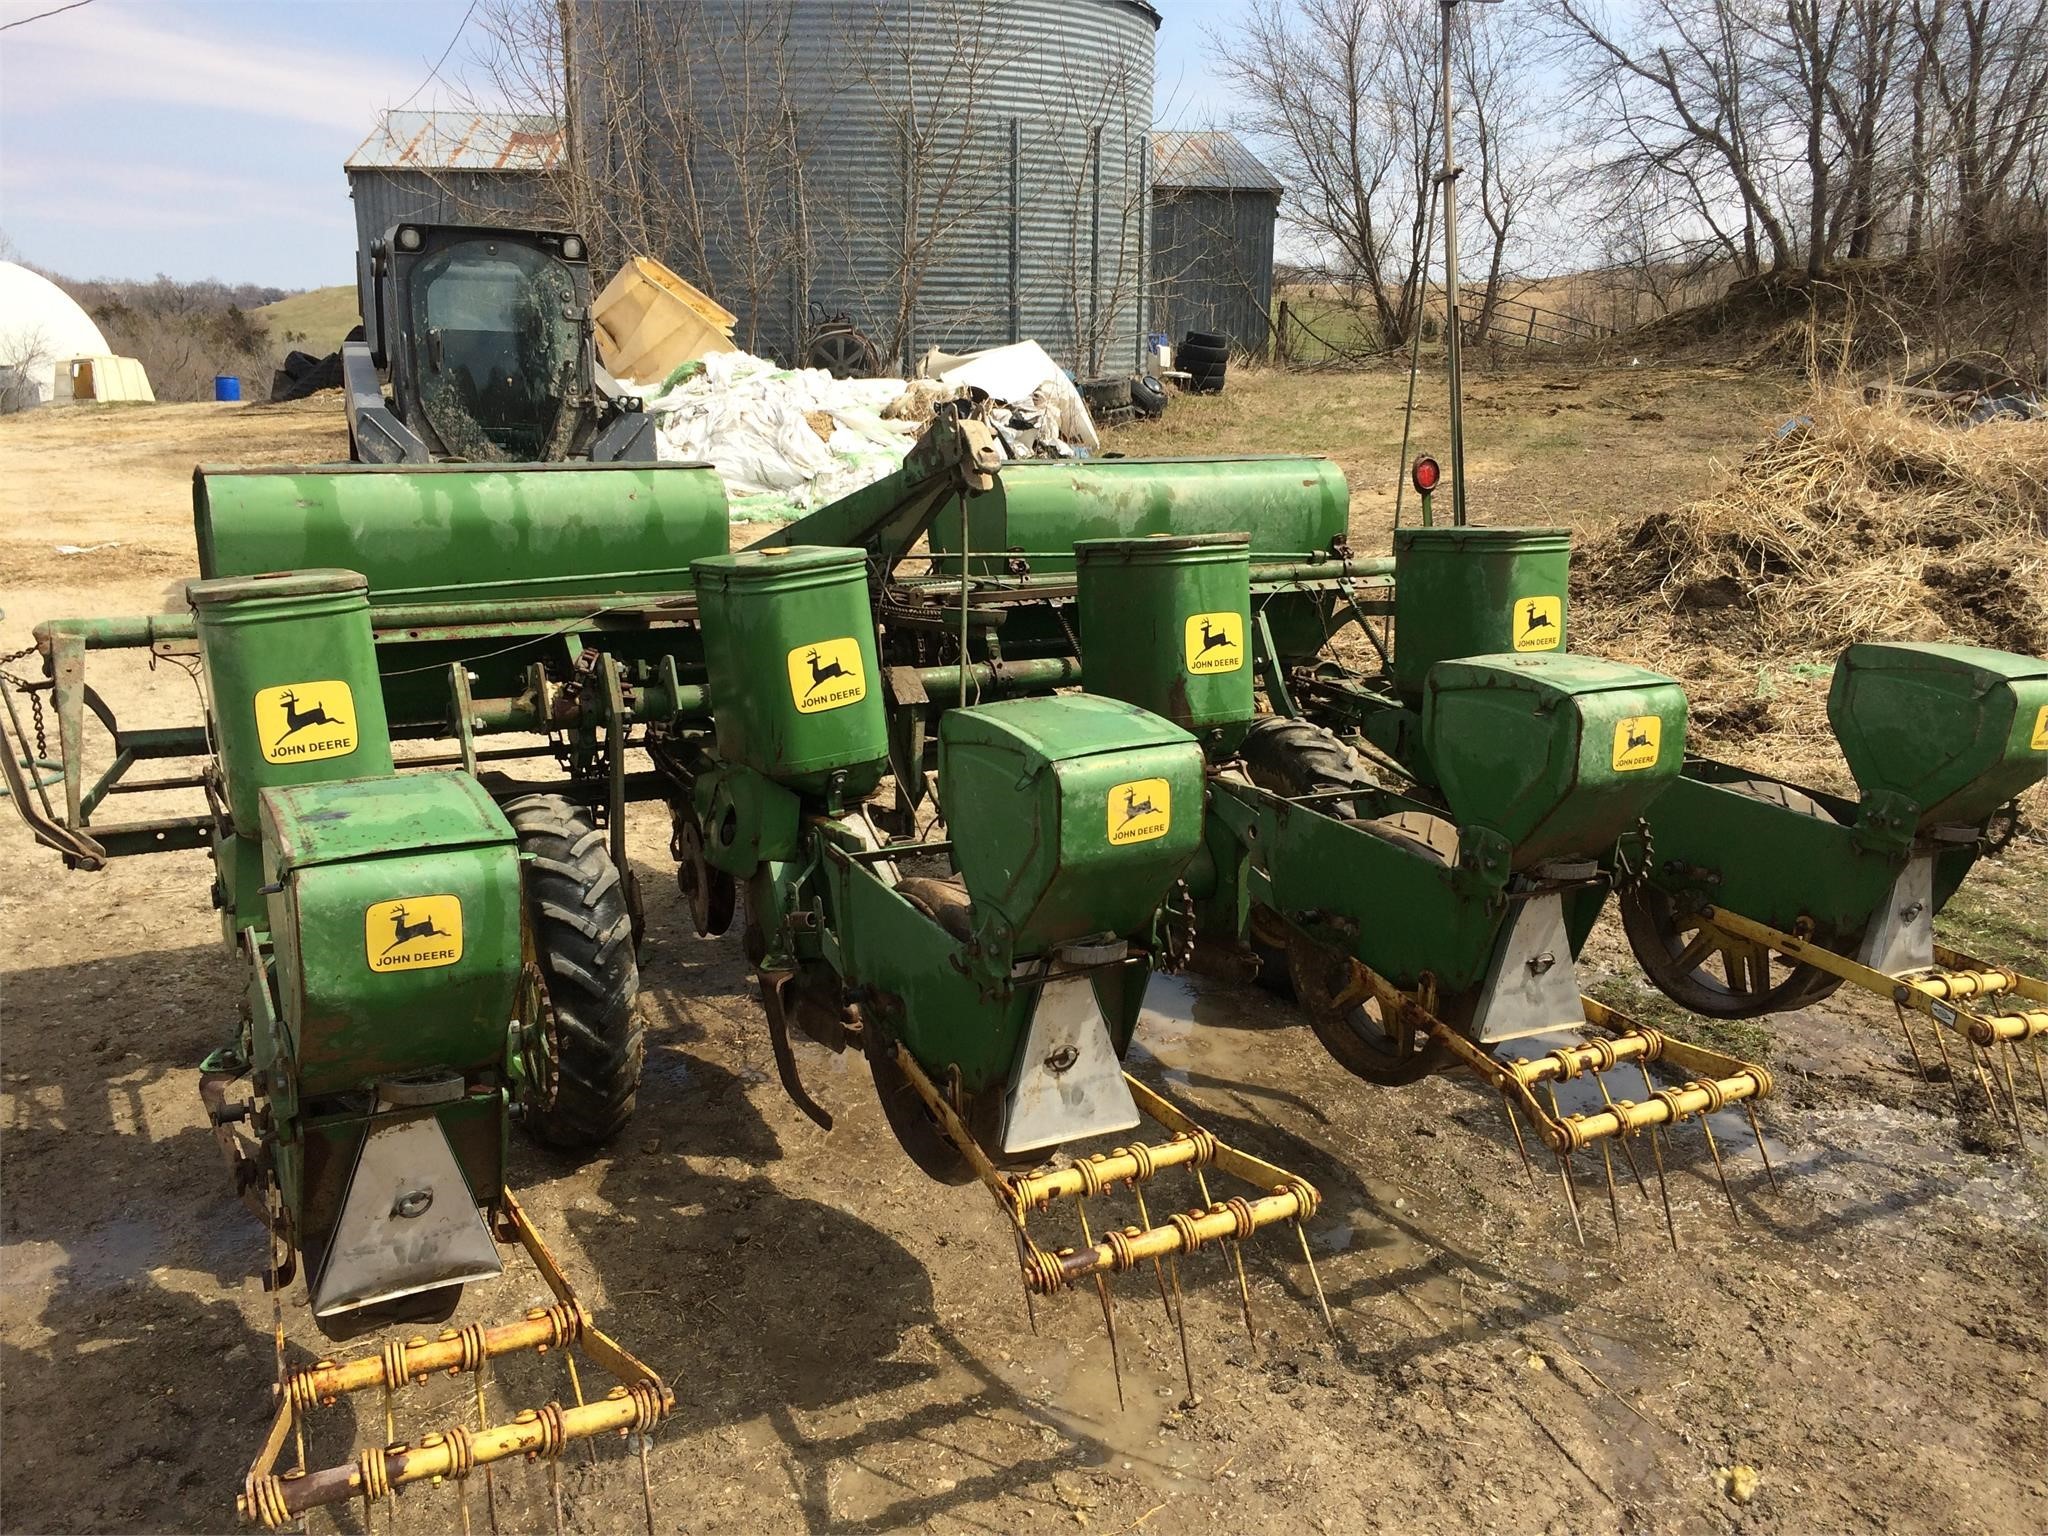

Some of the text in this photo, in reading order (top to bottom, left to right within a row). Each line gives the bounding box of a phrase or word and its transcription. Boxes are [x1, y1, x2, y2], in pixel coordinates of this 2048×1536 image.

[1192, 657, 1239, 670] JOHN DEERE
[801, 687, 861, 709] JOHN DEERE
[271, 739, 351, 758] JOHN DEERE
[1113, 823, 1165, 841] JOHN DEERE
[376, 949, 455, 967] JOHN DEERE
